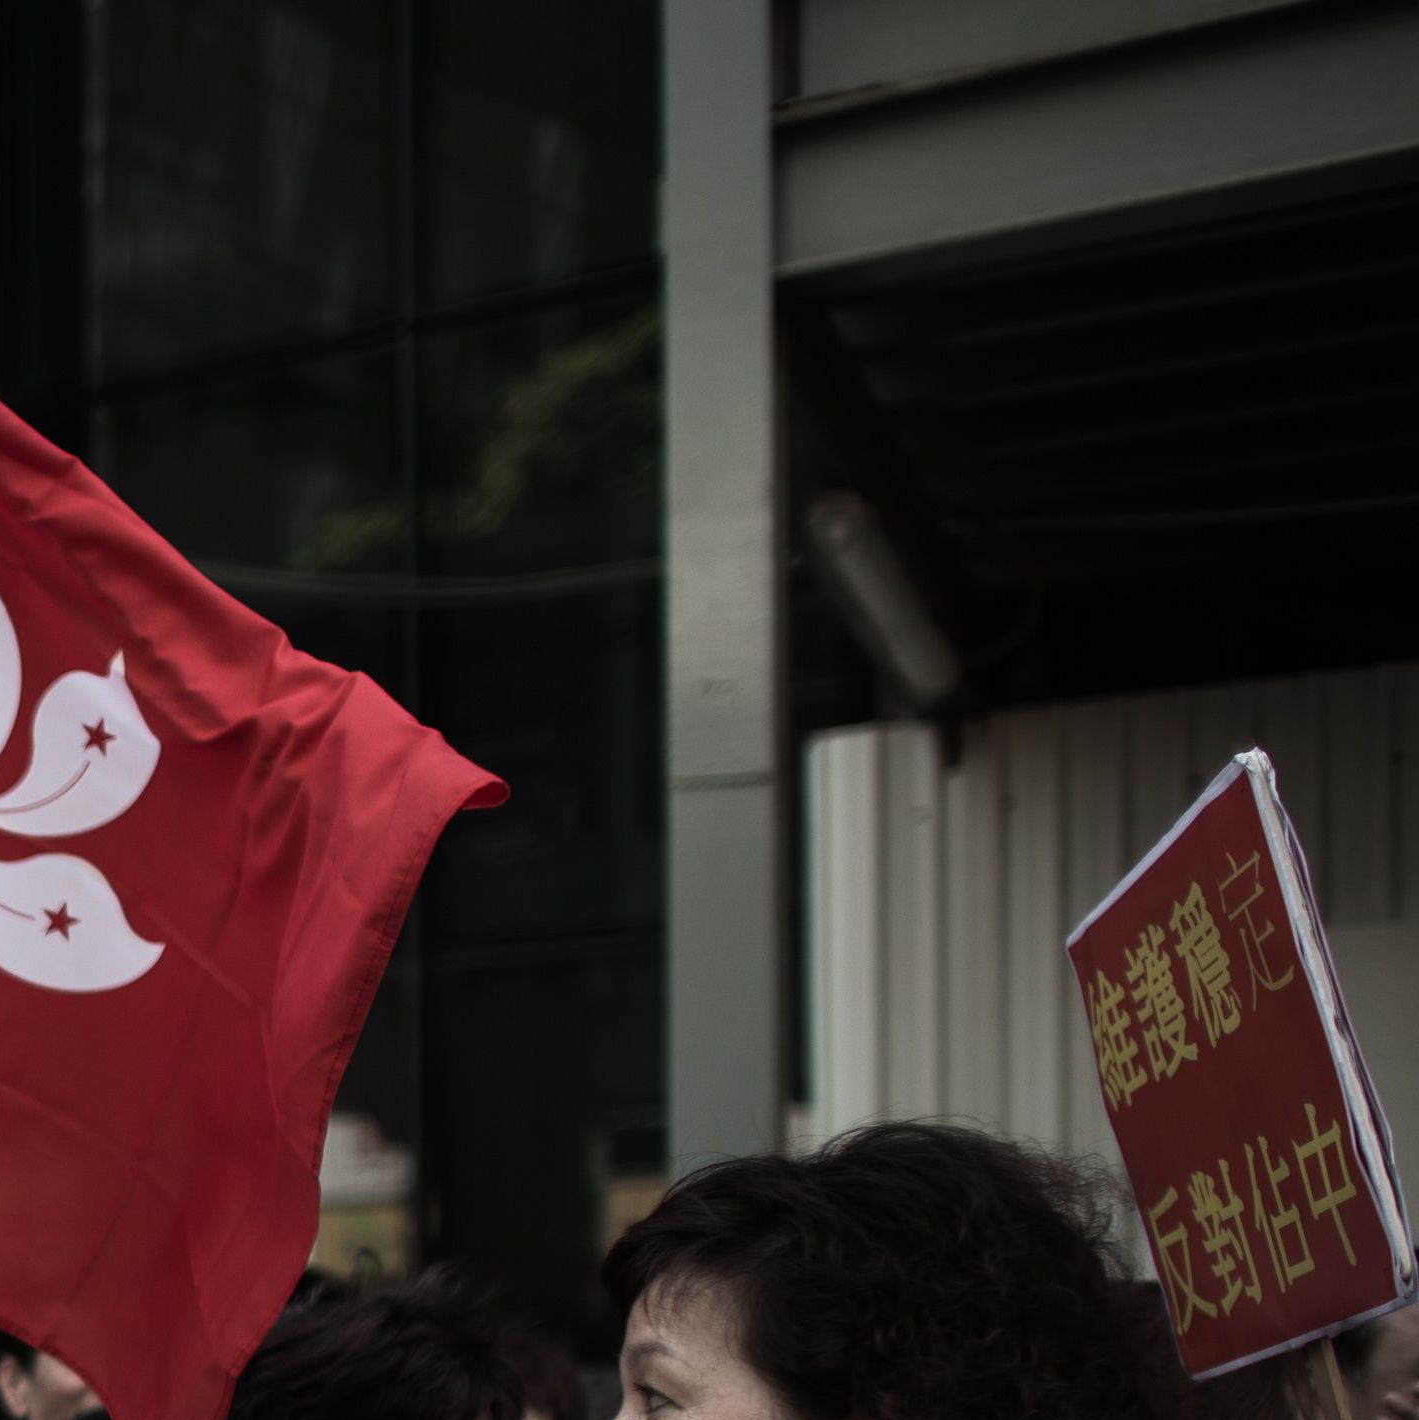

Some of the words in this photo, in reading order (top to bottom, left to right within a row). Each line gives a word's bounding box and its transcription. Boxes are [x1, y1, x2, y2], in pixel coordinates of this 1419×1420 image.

[1085, 848, 1295, 1112] 維護穩定
[1145, 1102, 1357, 1336] 反對佔中
